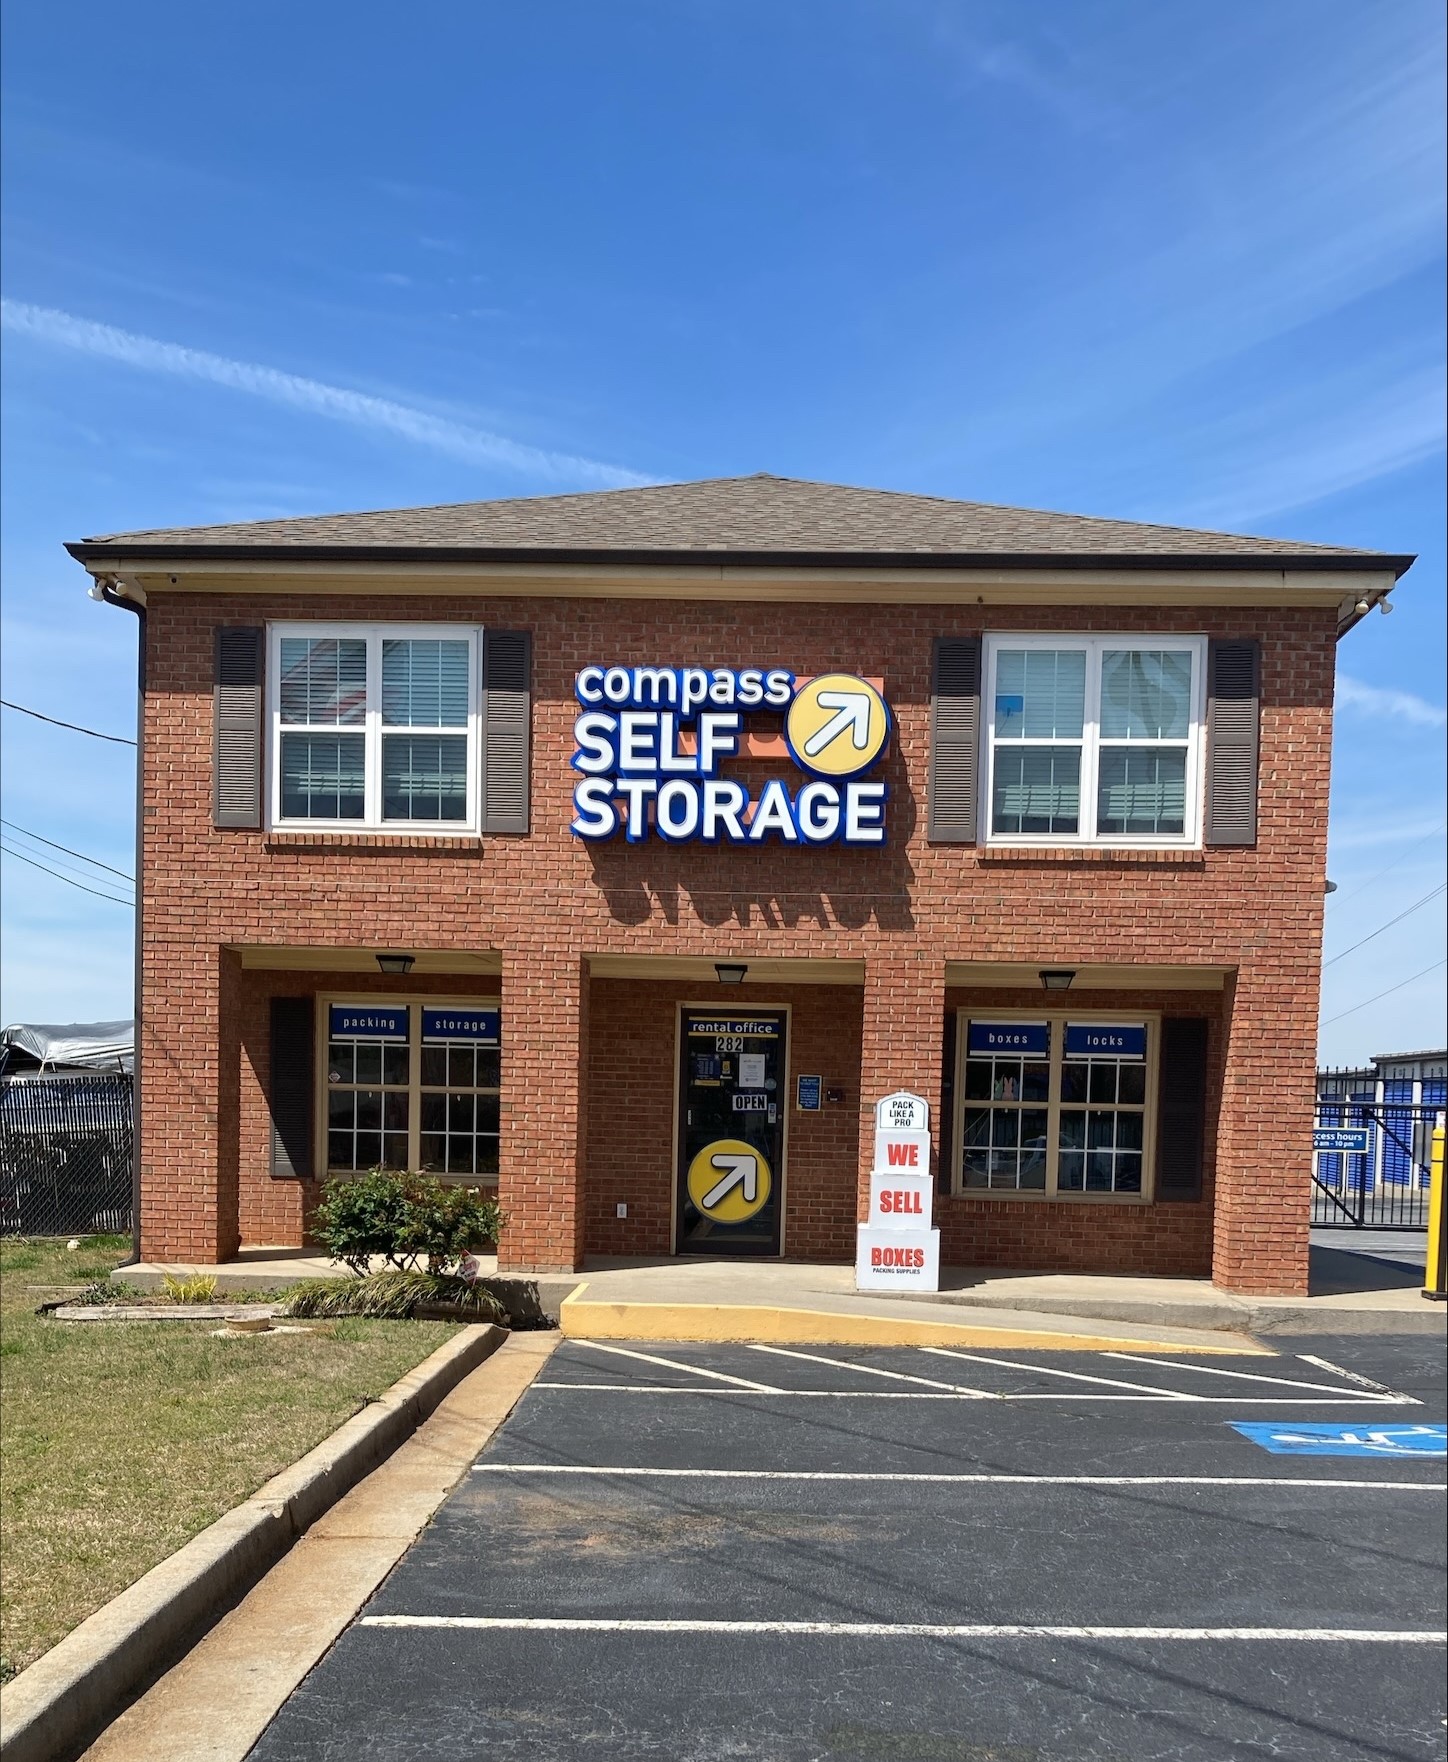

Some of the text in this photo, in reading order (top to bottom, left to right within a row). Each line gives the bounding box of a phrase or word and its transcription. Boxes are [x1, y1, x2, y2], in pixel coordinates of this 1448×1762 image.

[576, 666, 793, 715] compass
[573, 711, 740, 774] SELF
[571, 776, 886, 841] STORAGE
[343, 1017, 396, 1030] packing
[435, 1019, 487, 1032] storage
[692, 1022, 773, 1034] rental office
[717, 1037, 743, 1051] 282
[988, 1032, 1028, 1044] boxes
[1087, 1034, 1124, 1046] locks
[735, 1095, 765, 1110] OPEN
[892, 1101, 914, 1109] PACK
[889, 1110, 914, 1118] LIKE A
[894, 1118, 911, 1127] PRO
[1337, 1131, 1363, 1141] hours
[887, 1143, 919, 1167] WE
[879, 1190, 923, 1214] SELL
[871, 1247, 925, 1268] BOXES
